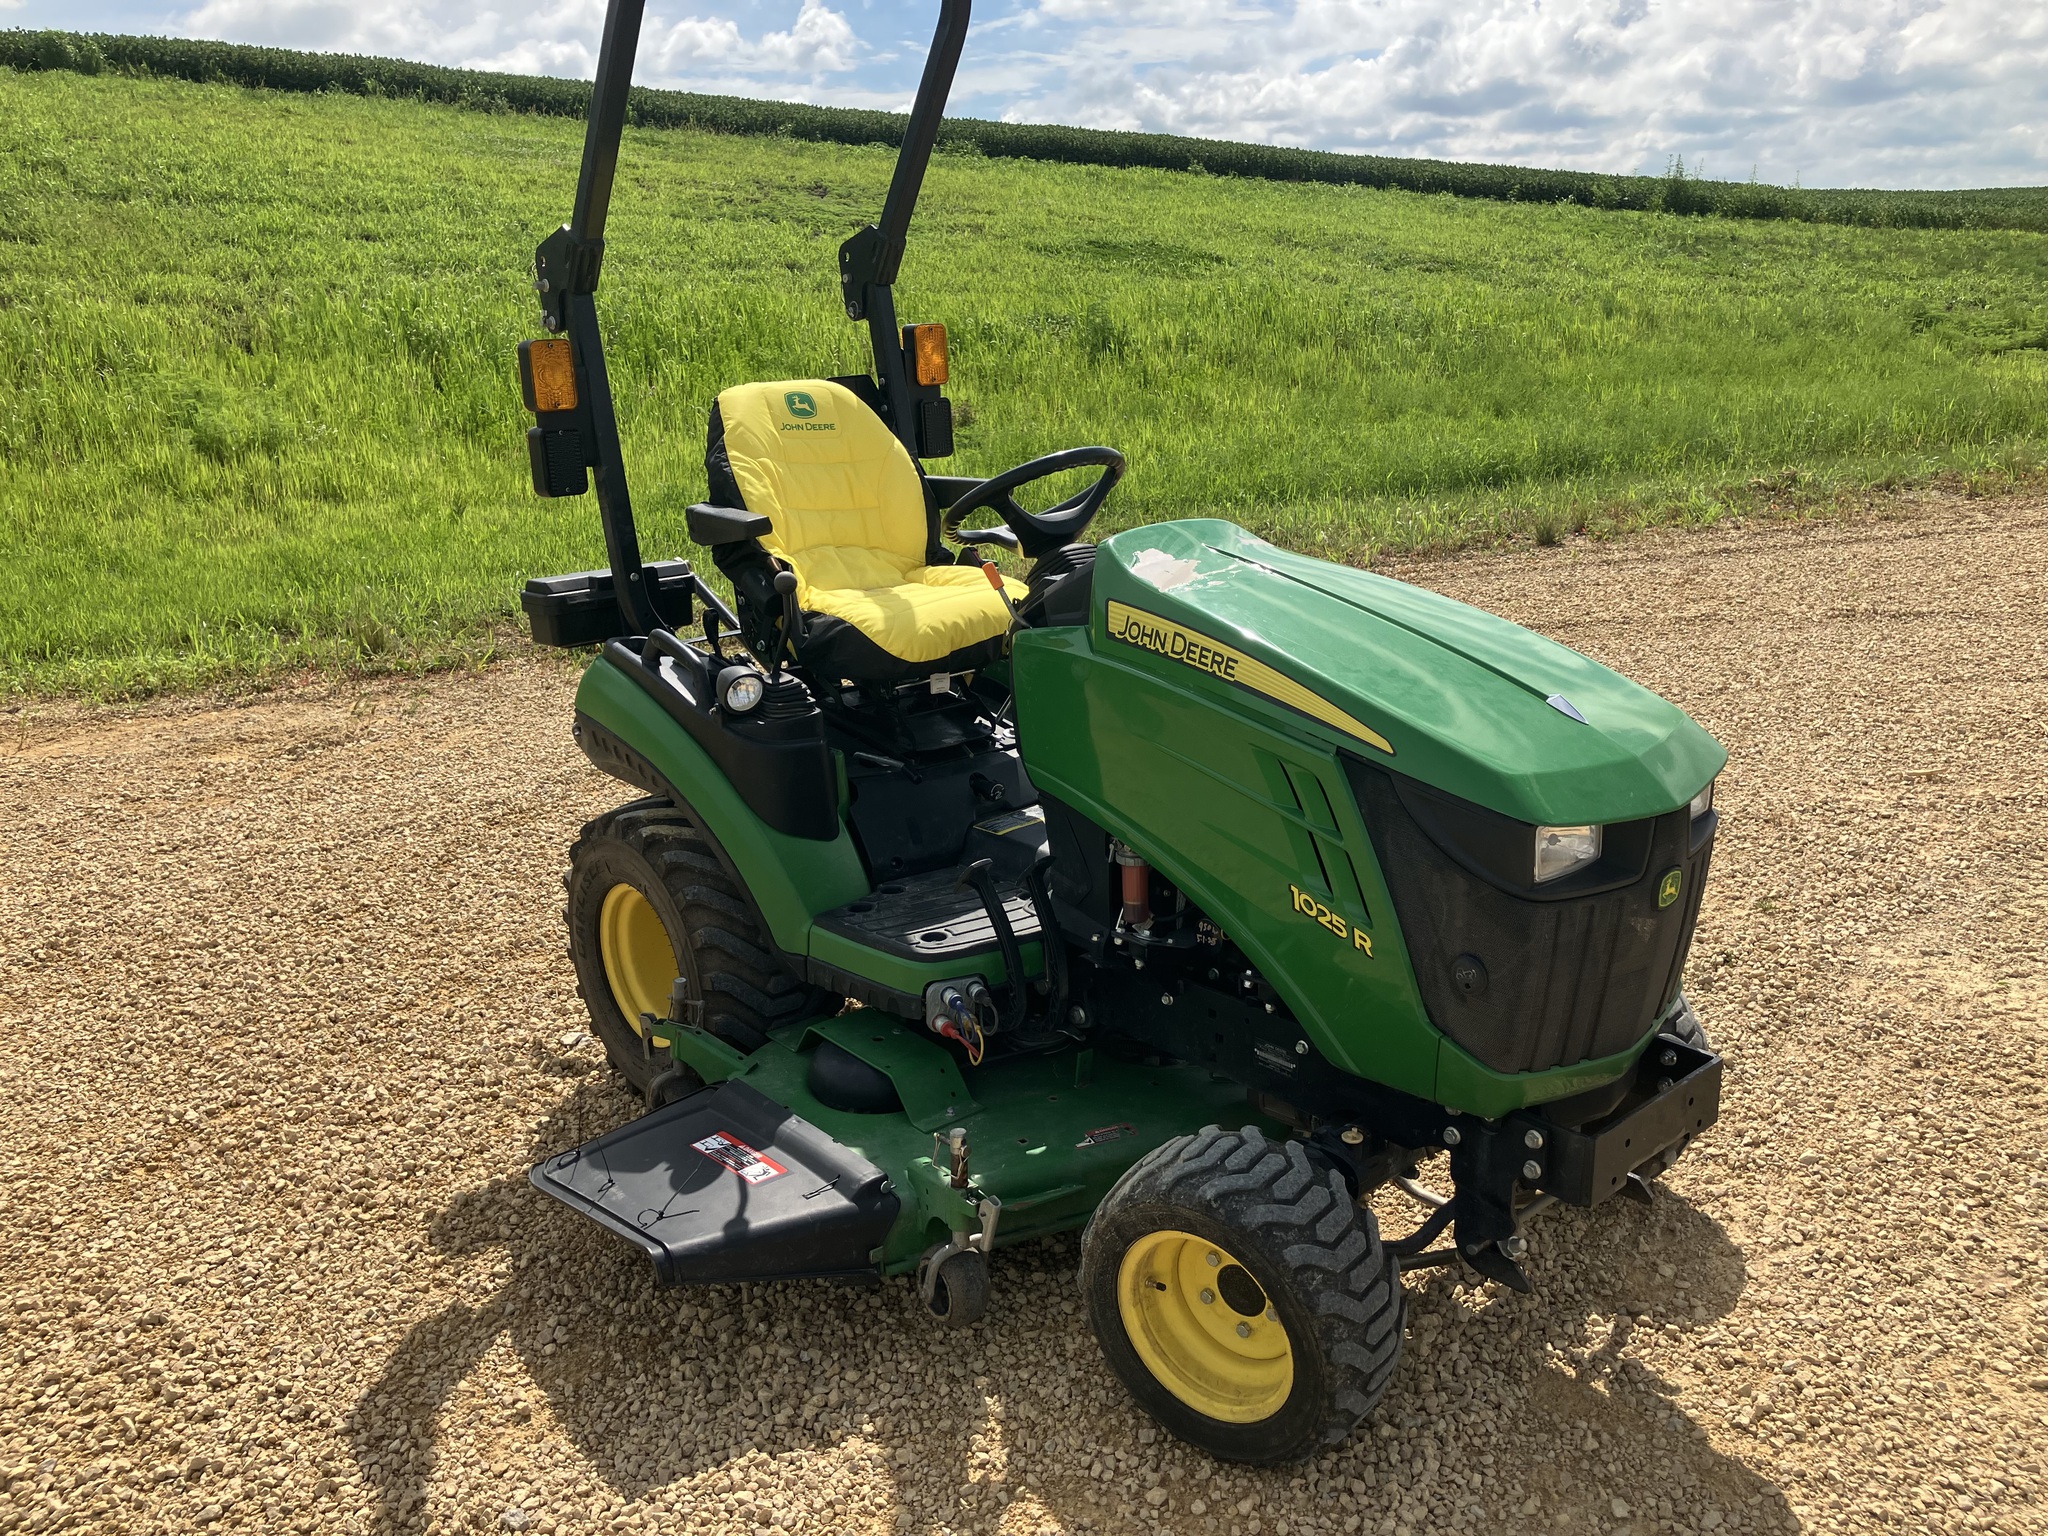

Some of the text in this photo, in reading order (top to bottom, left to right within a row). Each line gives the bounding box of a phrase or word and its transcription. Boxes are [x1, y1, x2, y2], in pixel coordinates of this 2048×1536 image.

[781, 422, 836, 431] JOHN DEERE
[1117, 615, 1239, 679] JOHN DEERE
[1289, 884, 1374, 958] 1025 R
